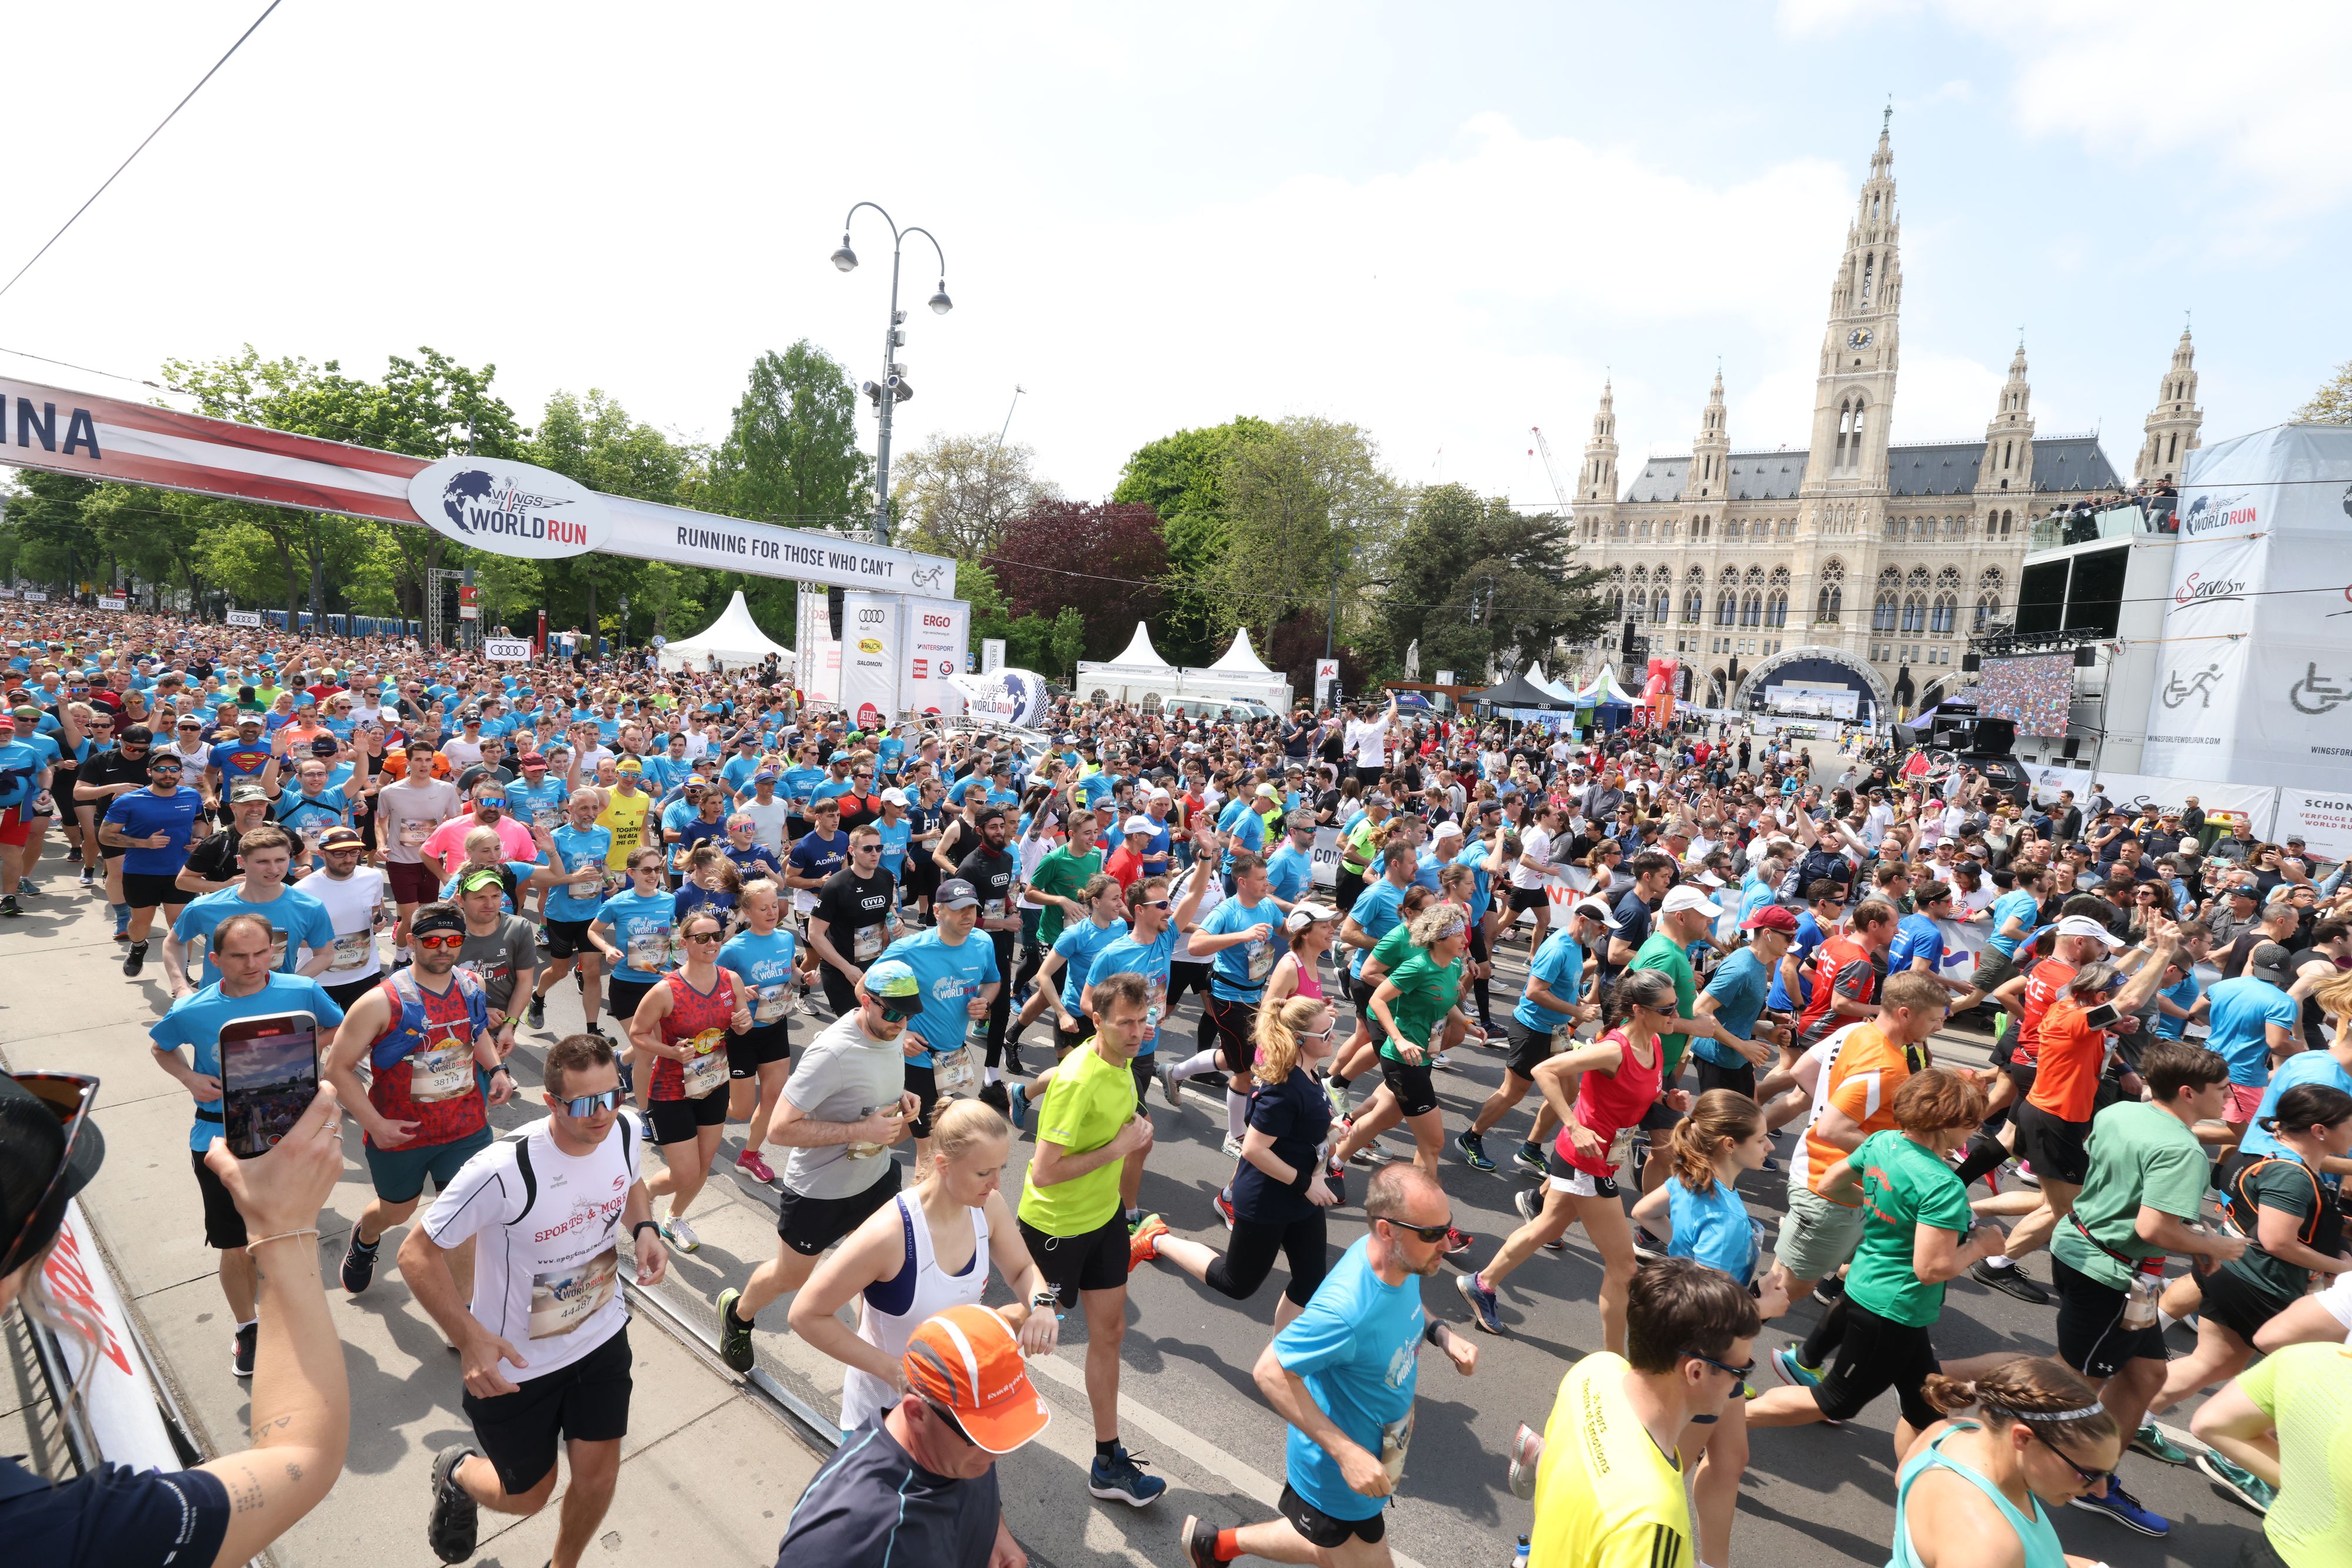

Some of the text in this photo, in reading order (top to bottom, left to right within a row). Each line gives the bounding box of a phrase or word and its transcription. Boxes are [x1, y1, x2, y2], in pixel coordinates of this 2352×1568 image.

[492, 489, 543, 507] WINGS
[2206, 498, 2231, 510] WINGS
[498, 499, 529, 514] LIFE
[677, 526, 894, 577] RUNNING FOR THOSE WHO CAN'T
[2176, 573, 2234, 603] Servus
[923, 614, 950, 627] ERGO
[1320, 665, 1335, 677] AK
[980, 683, 1008, 693] WINGS
[1269, 687, 1284, 696] INFO
[981, 692, 998, 701] LIFE
[860, 710, 876, 721] JETZT
[2300, 813, 2346, 822] VERFOLGE
[864, 898, 884, 906] EVVA
[634, 927, 657, 935] WORLD
[1819, 948, 1836, 978] PCE
[759, 968, 783, 981] WORLD
[940, 986, 977, 999] WORLD RUN
[435, 1059, 466, 1073] WORLD RUN
[700, 1065, 714, 1075] WORLD
[433, 1075, 459, 1086] 38114
[700, 1076, 717, 1086] 37781
[550, 1179, 567, 1189] erima
[534, 1213, 583, 1243] SPORTS
[587, 1208, 596, 1219] &
[563, 1275, 604, 1299] WORLD RUN
[560, 1295, 593, 1318] 44487
[1595, 1404, 1608, 1433] Years
[1588, 1422, 1610, 1474] Emotions
